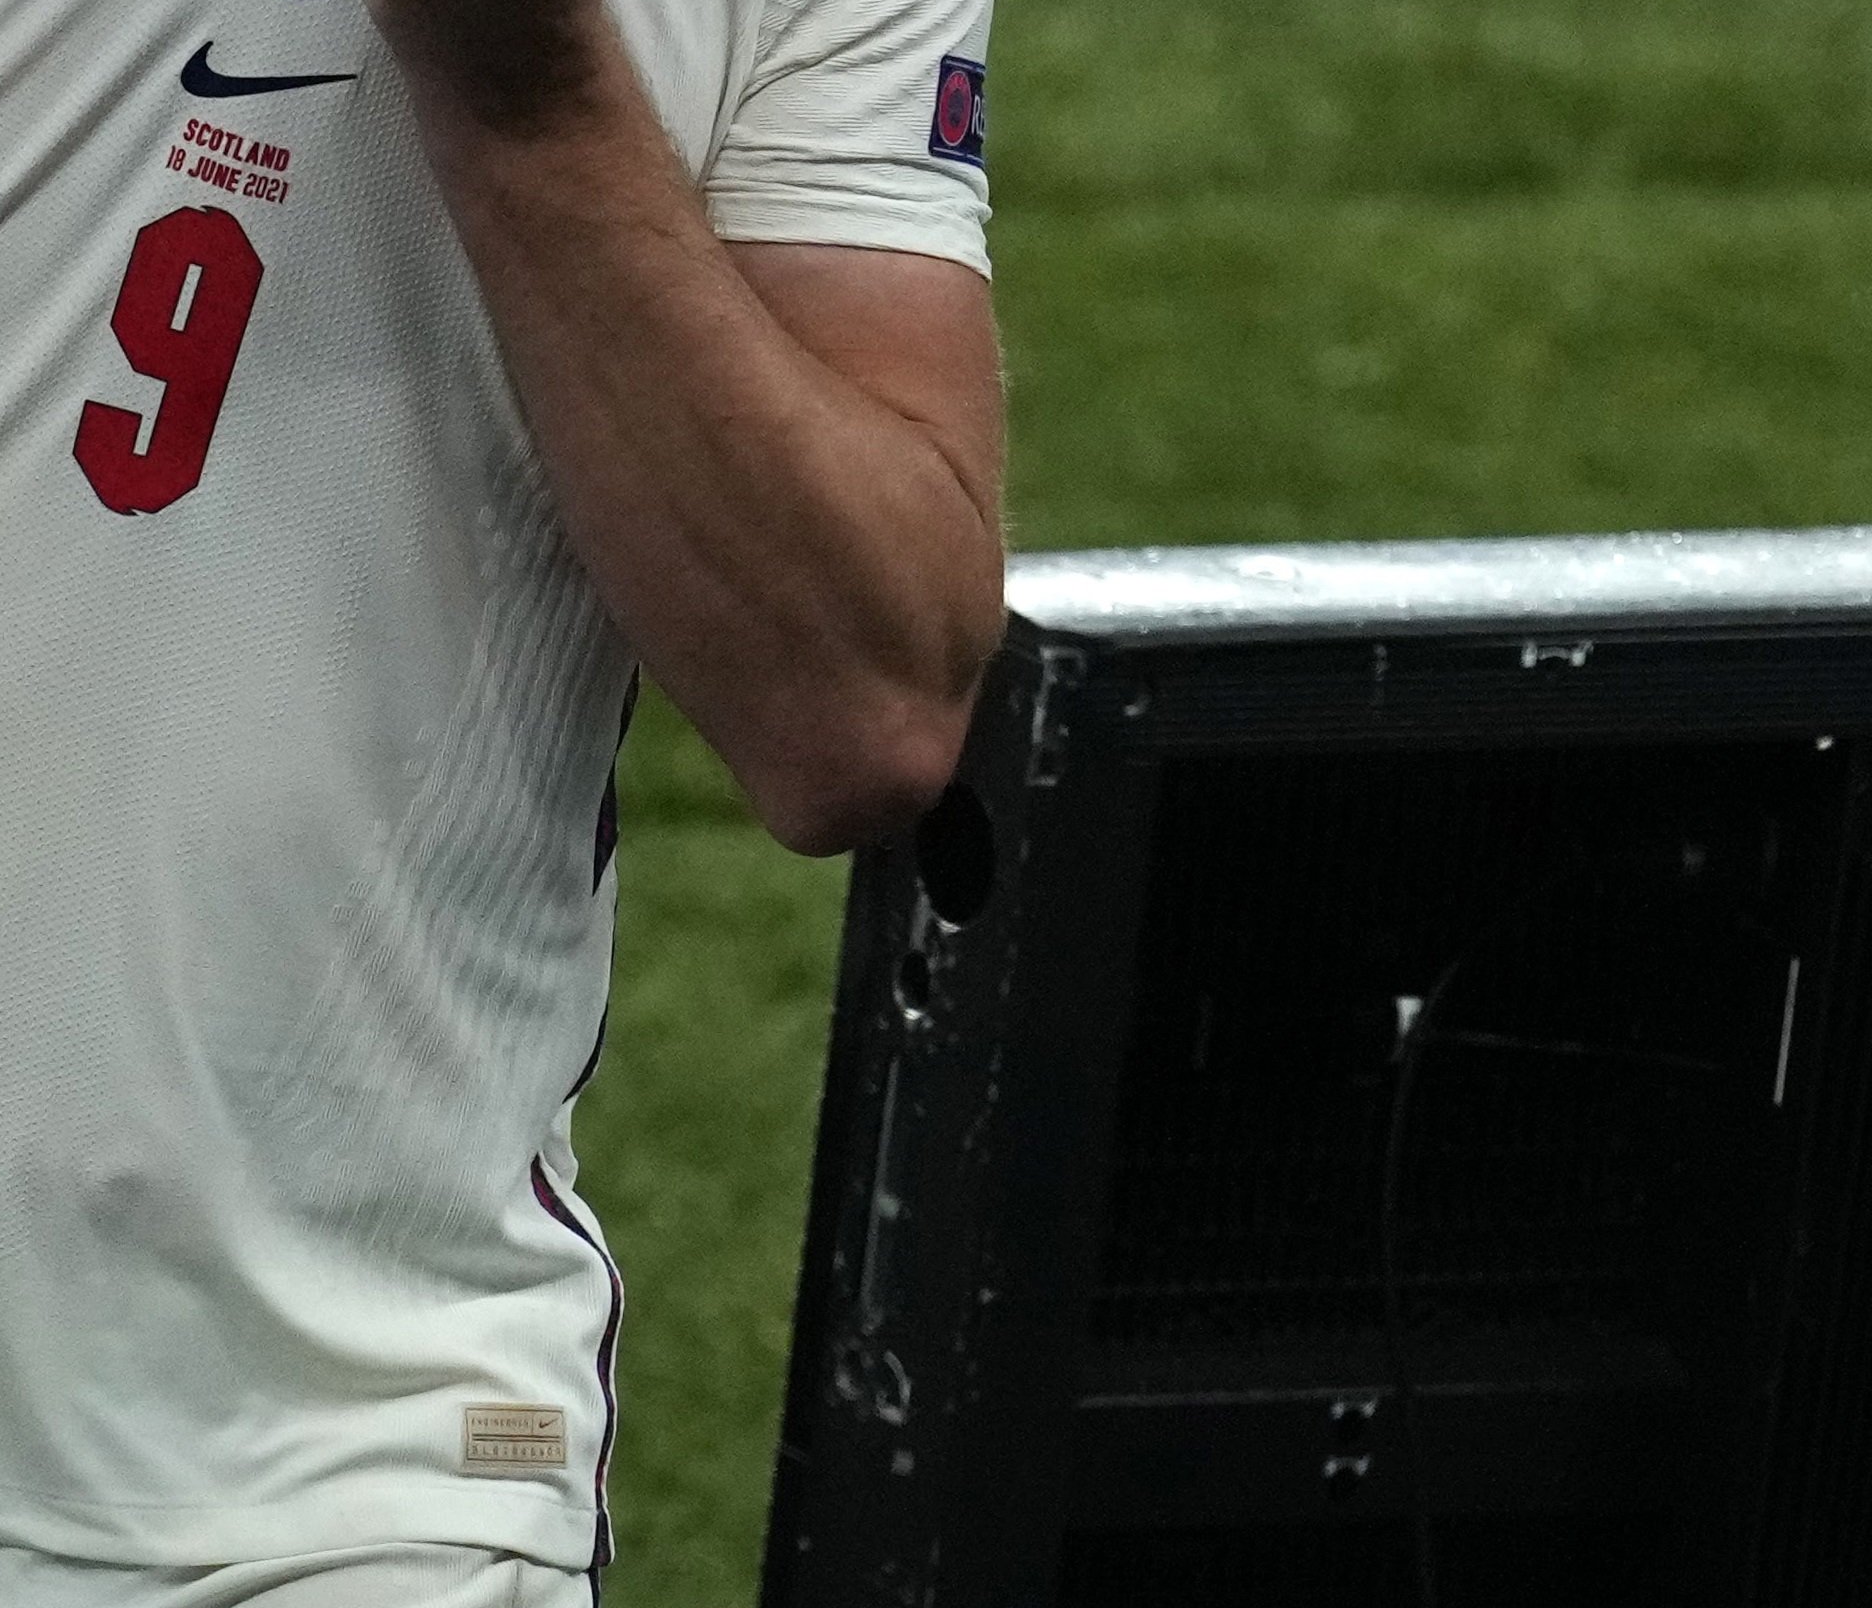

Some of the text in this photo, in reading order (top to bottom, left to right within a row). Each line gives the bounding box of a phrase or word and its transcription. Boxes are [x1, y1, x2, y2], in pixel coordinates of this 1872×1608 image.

[183, 118, 290, 171] SCOTLAND
[166, 145, 289, 204] 18 JUNE 2021
[72, 205, 265, 516] 9
